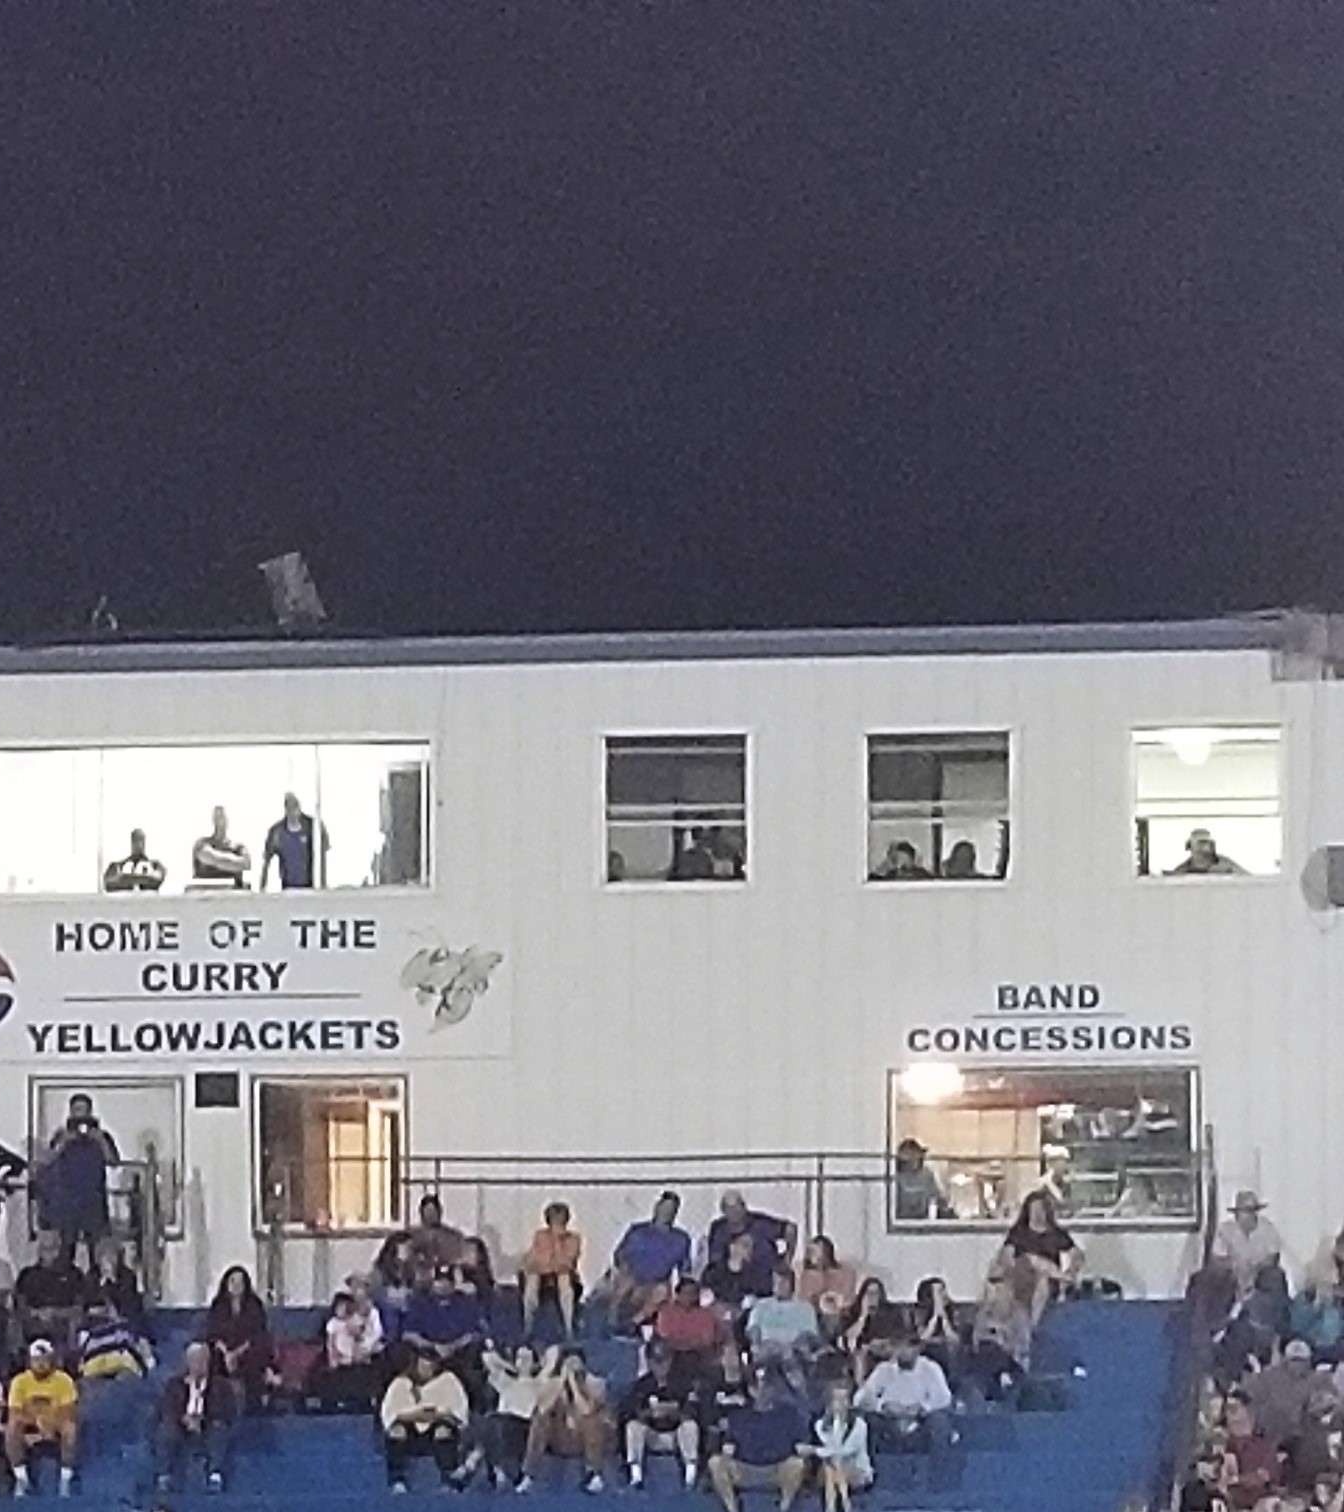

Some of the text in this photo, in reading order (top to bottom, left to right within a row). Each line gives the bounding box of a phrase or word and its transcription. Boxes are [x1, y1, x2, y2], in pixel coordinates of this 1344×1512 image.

[55, 919, 376, 951] HOME OF THE
[141, 962, 288, 992] CURRY
[997, 984, 1100, 1011] BAND
[27, 1020, 401, 1053] YELLOWJACKETS
[907, 1025, 1193, 1053] CONCESSIONS
